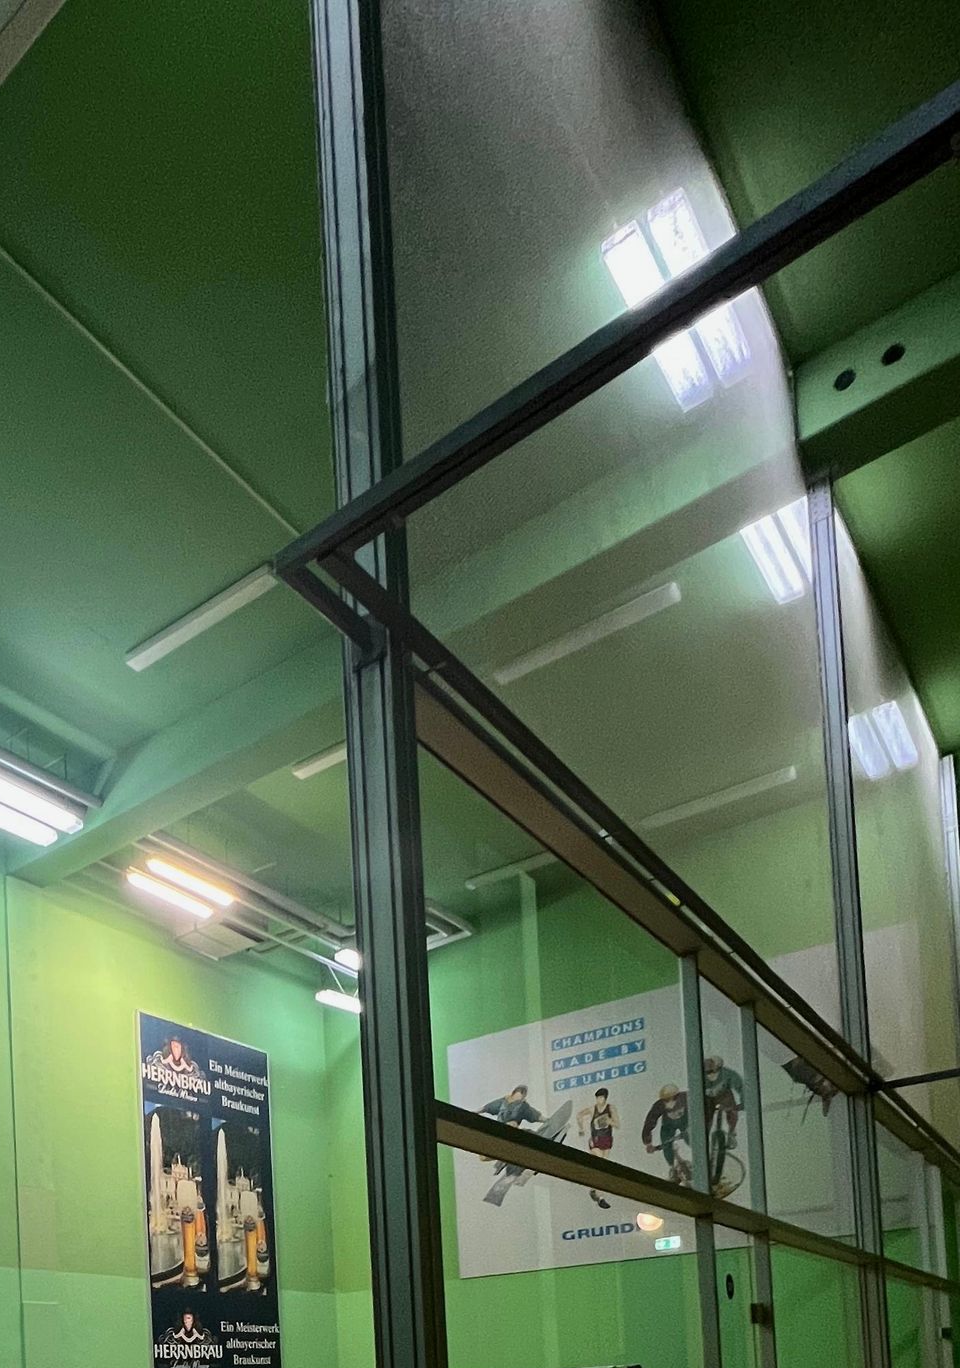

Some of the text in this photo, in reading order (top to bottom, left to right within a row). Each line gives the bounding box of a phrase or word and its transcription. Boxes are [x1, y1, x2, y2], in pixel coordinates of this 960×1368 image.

[553, 1019, 643, 1050] CHAMPIONS
[554, 1041, 644, 1070] MADE BY
[209, 1059, 223, 1074] Ein
[556, 1062, 645, 1090] GRUNDIG
[222, 1095, 260, 1115] Braukunst
[562, 1222, 640, 1240] GRUND
[220, 1321, 280, 1334] Ein Meisterwerk
[226, 1338, 276, 1351] altbayerischer
[233, 1354, 271, 1365] Braukunst
